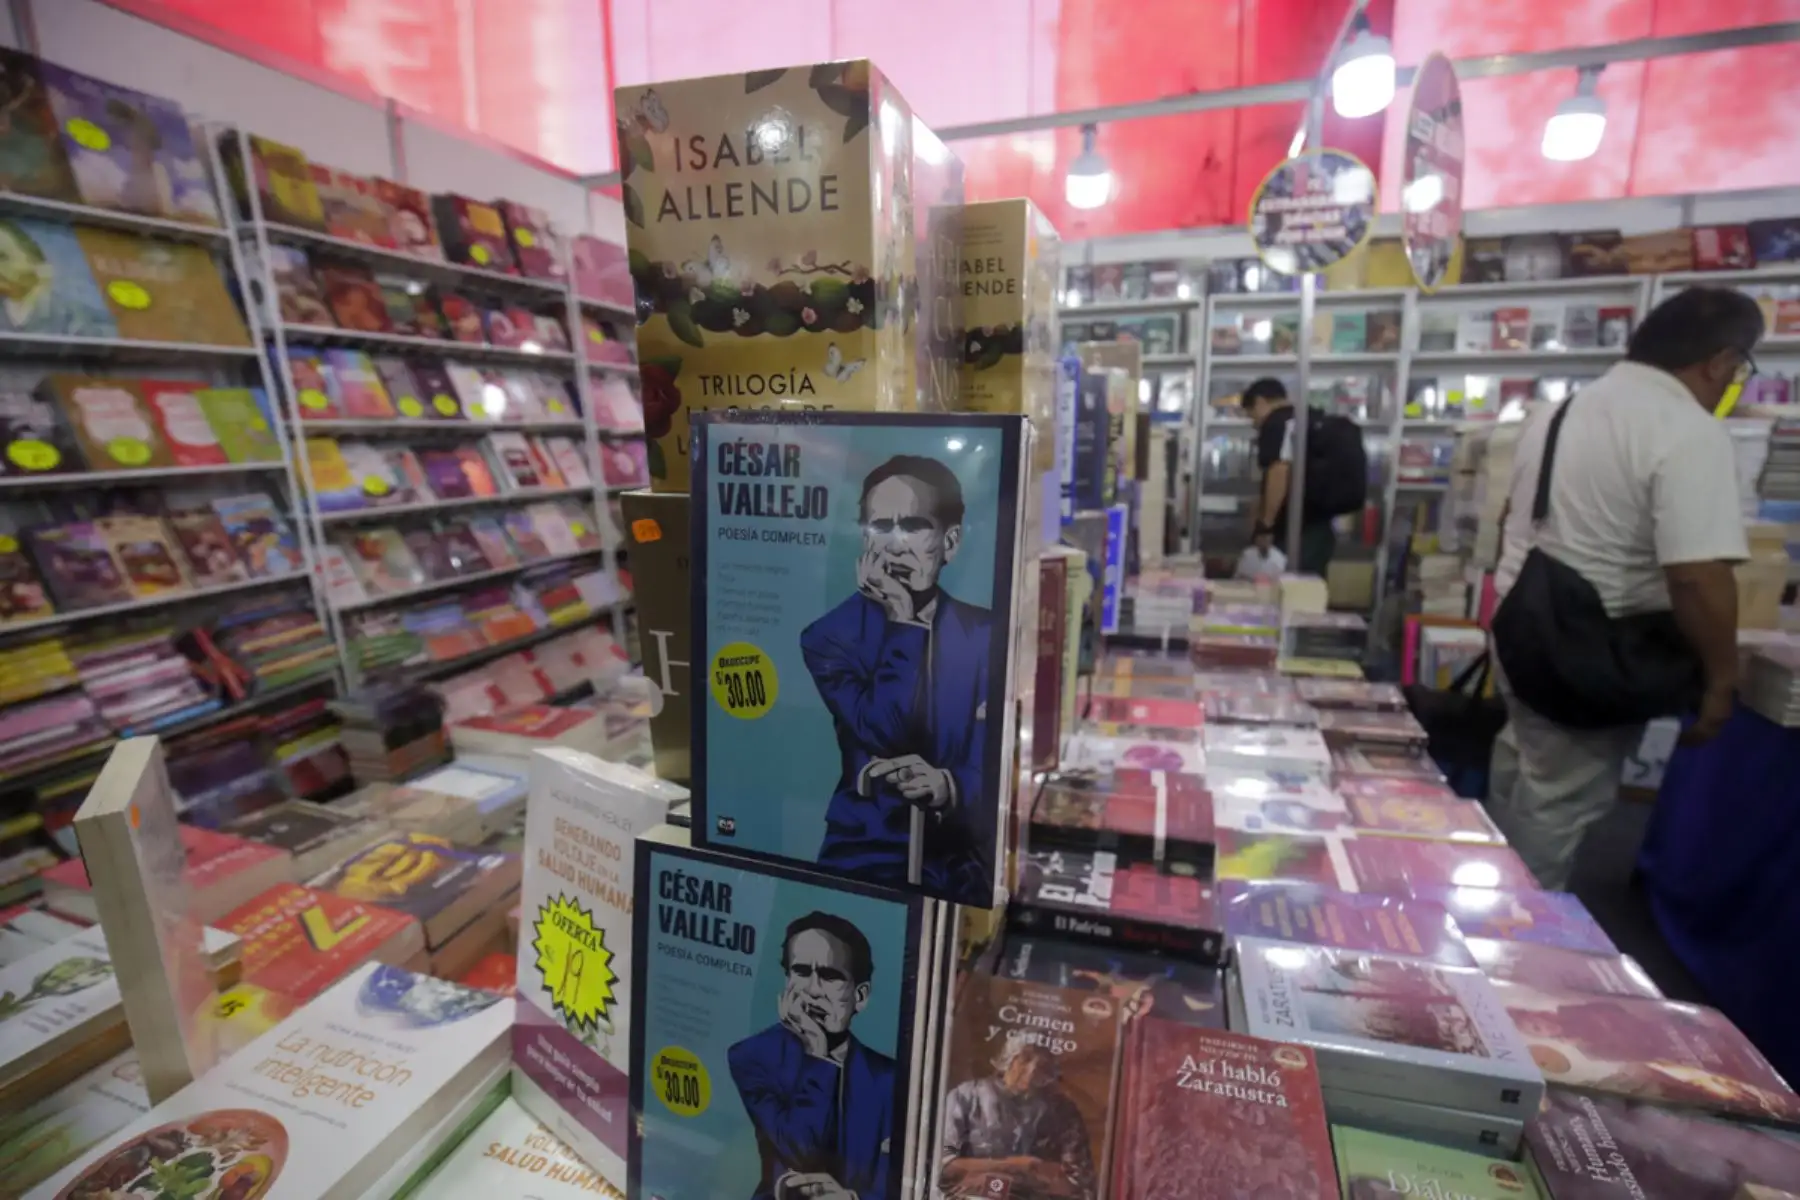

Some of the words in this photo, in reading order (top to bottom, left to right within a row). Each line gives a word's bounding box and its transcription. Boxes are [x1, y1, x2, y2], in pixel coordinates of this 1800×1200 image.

[674, 125, 814, 172] ISABEL
[656, 174, 839, 223] ALLENDE
[699, 366, 816, 396] TRILOGÍA
[718, 436, 801, 478] CÉSAR
[717, 481, 829, 521] VALLEJO
[718, 526, 759, 542] POESÍA
[761, 529, 827, 546] COMPLETA
[724, 669, 767, 709] 30.00
[538, 847, 576, 883] SALUD
[658, 868, 733, 914] CÉSAR
[552, 911, 598, 952] OFERTA
[658, 903, 756, 955] VALLEJO
[656, 942, 694, 961] POESÍA
[695, 953, 753, 977] COMPLETA
[998, 1004, 1076, 1033] Crimen
[275, 1027, 311, 1054] La
[305, 1044, 412, 1087] nutrición
[984, 1025, 1002, 1042] y
[1005, 1029, 1078, 1055] castigo
[254, 1054, 375, 1108] inteligente
[664, 1070, 700, 1109] 30.00
[1176, 1054, 1216, 1075] Así
[1220, 1060, 1281, 1087] habló
[1176, 1069, 1288, 1107] Zaratustra
[483, 1141, 549, 1173] SALUD
[544, 1162, 627, 1199] HUMAN
